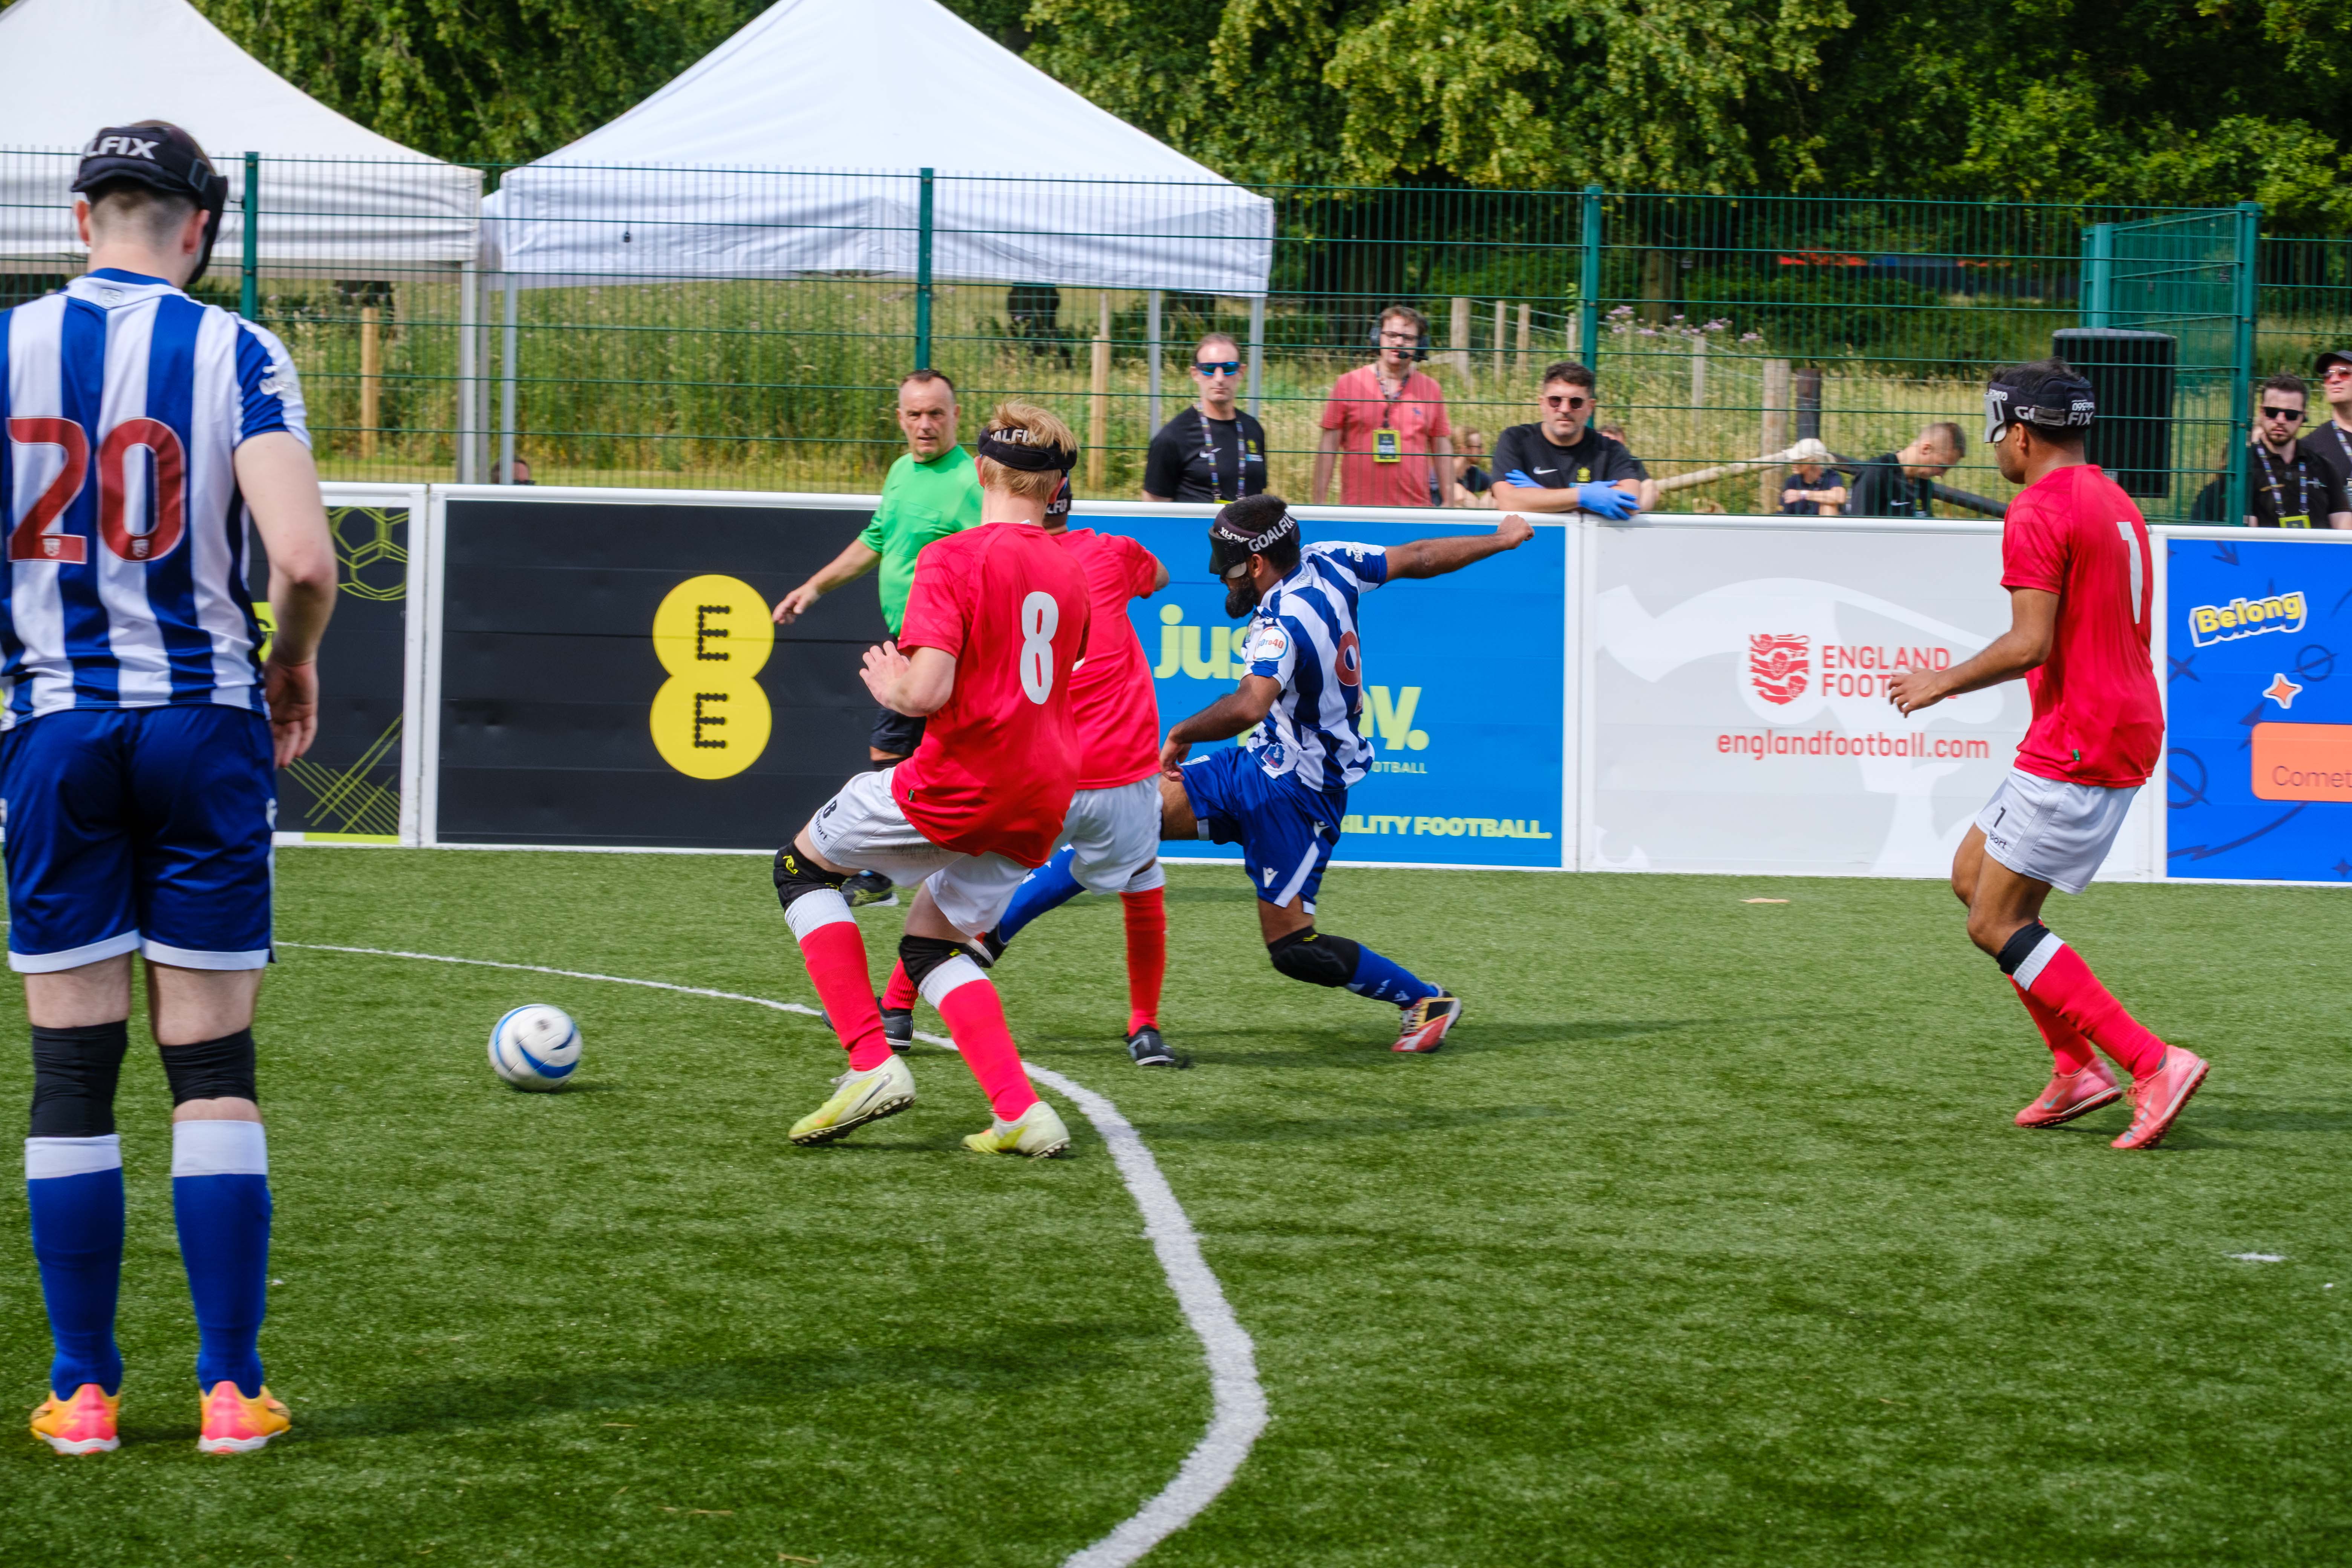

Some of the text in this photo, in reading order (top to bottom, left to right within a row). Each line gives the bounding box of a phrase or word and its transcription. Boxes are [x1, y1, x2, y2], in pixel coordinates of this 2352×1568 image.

[990, 429, 1038, 443] ALFI
[6, 416, 185, 564] 20
[1248, 513, 1295, 552] GOALFIX
[2116, 521, 2143, 624] 1
[2196, 594, 2300, 634] Belong
[1020, 591, 1059, 705] 8
[1154, 604, 1248, 681] jus
[1821, 645, 1950, 671] ENGLAND
[1717, 729, 1990, 760] englandfootball.com
[1371, 761, 1428, 774] OTBALL
[823, 799, 837, 819] 8
[1994, 806, 2006, 828] 1
[1414, 816, 1553, 839] FOOTBALL.
[1989, 830, 2007, 849] port
